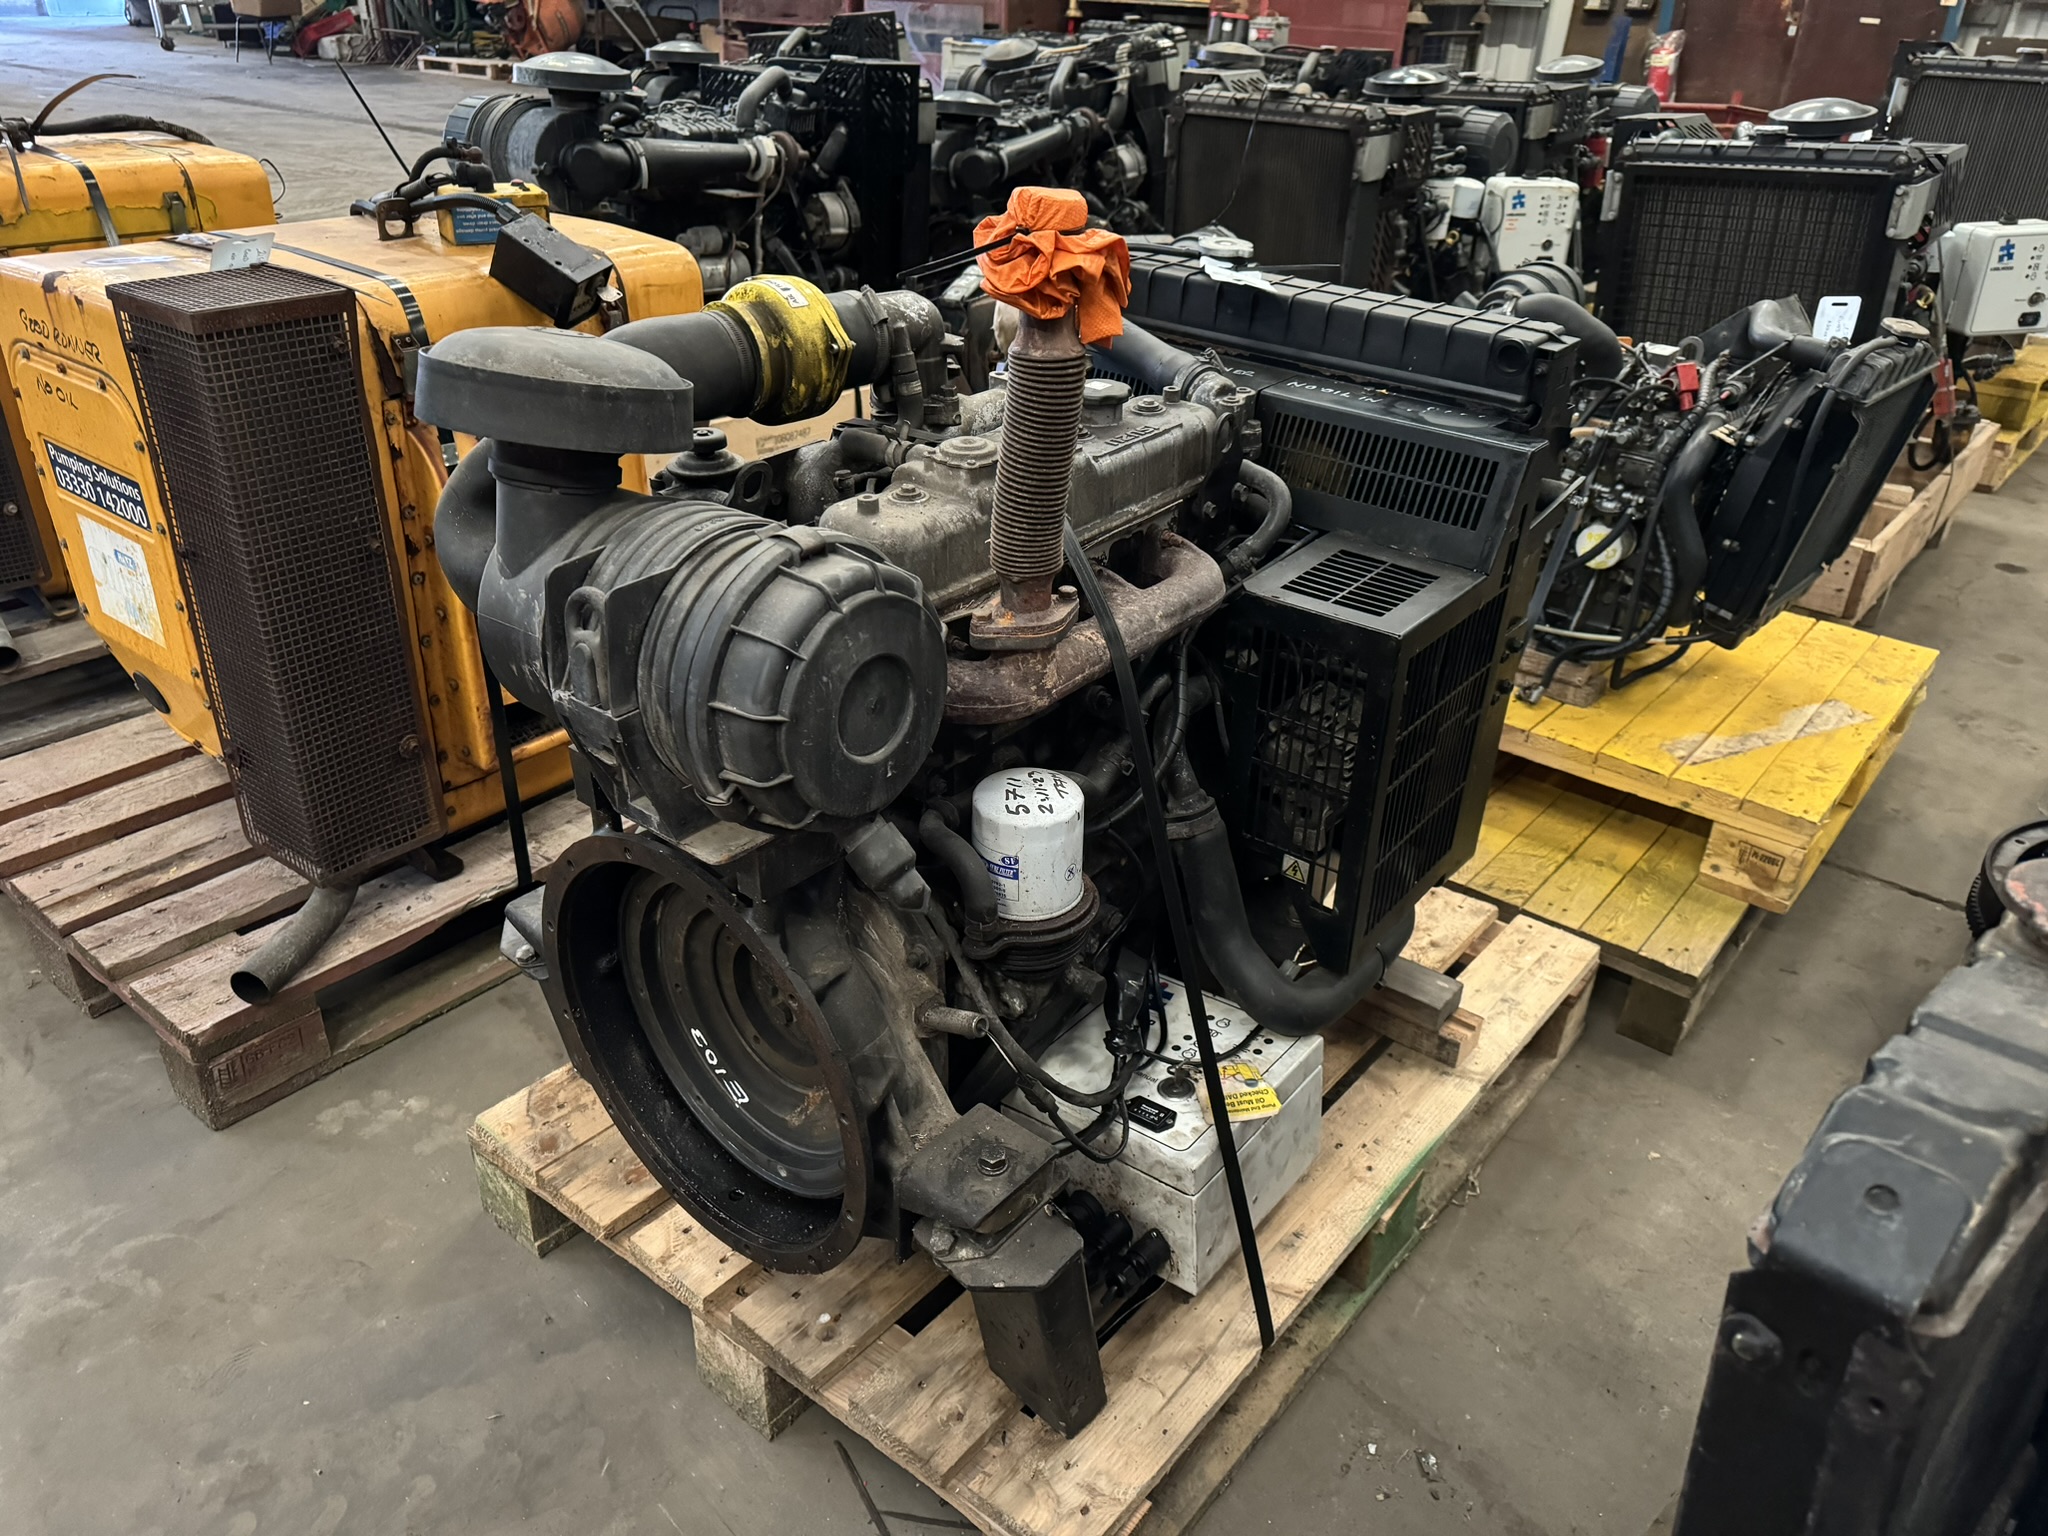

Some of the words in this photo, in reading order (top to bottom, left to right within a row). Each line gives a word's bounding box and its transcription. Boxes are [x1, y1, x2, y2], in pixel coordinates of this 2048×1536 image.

[53, 327, 103, 364] RUNNER
[36, 374, 53, 395] NO
[55, 386, 79, 410] OIL
[47, 443, 93, 483] Pumping
[91, 464, 142, 502] Solutions
[55, 466, 97, 503] 03330
[96, 486, 148, 528] 142000
[1004, 777, 1030, 816] 5711
[1240, 1088, 1269, 1098] Checked
